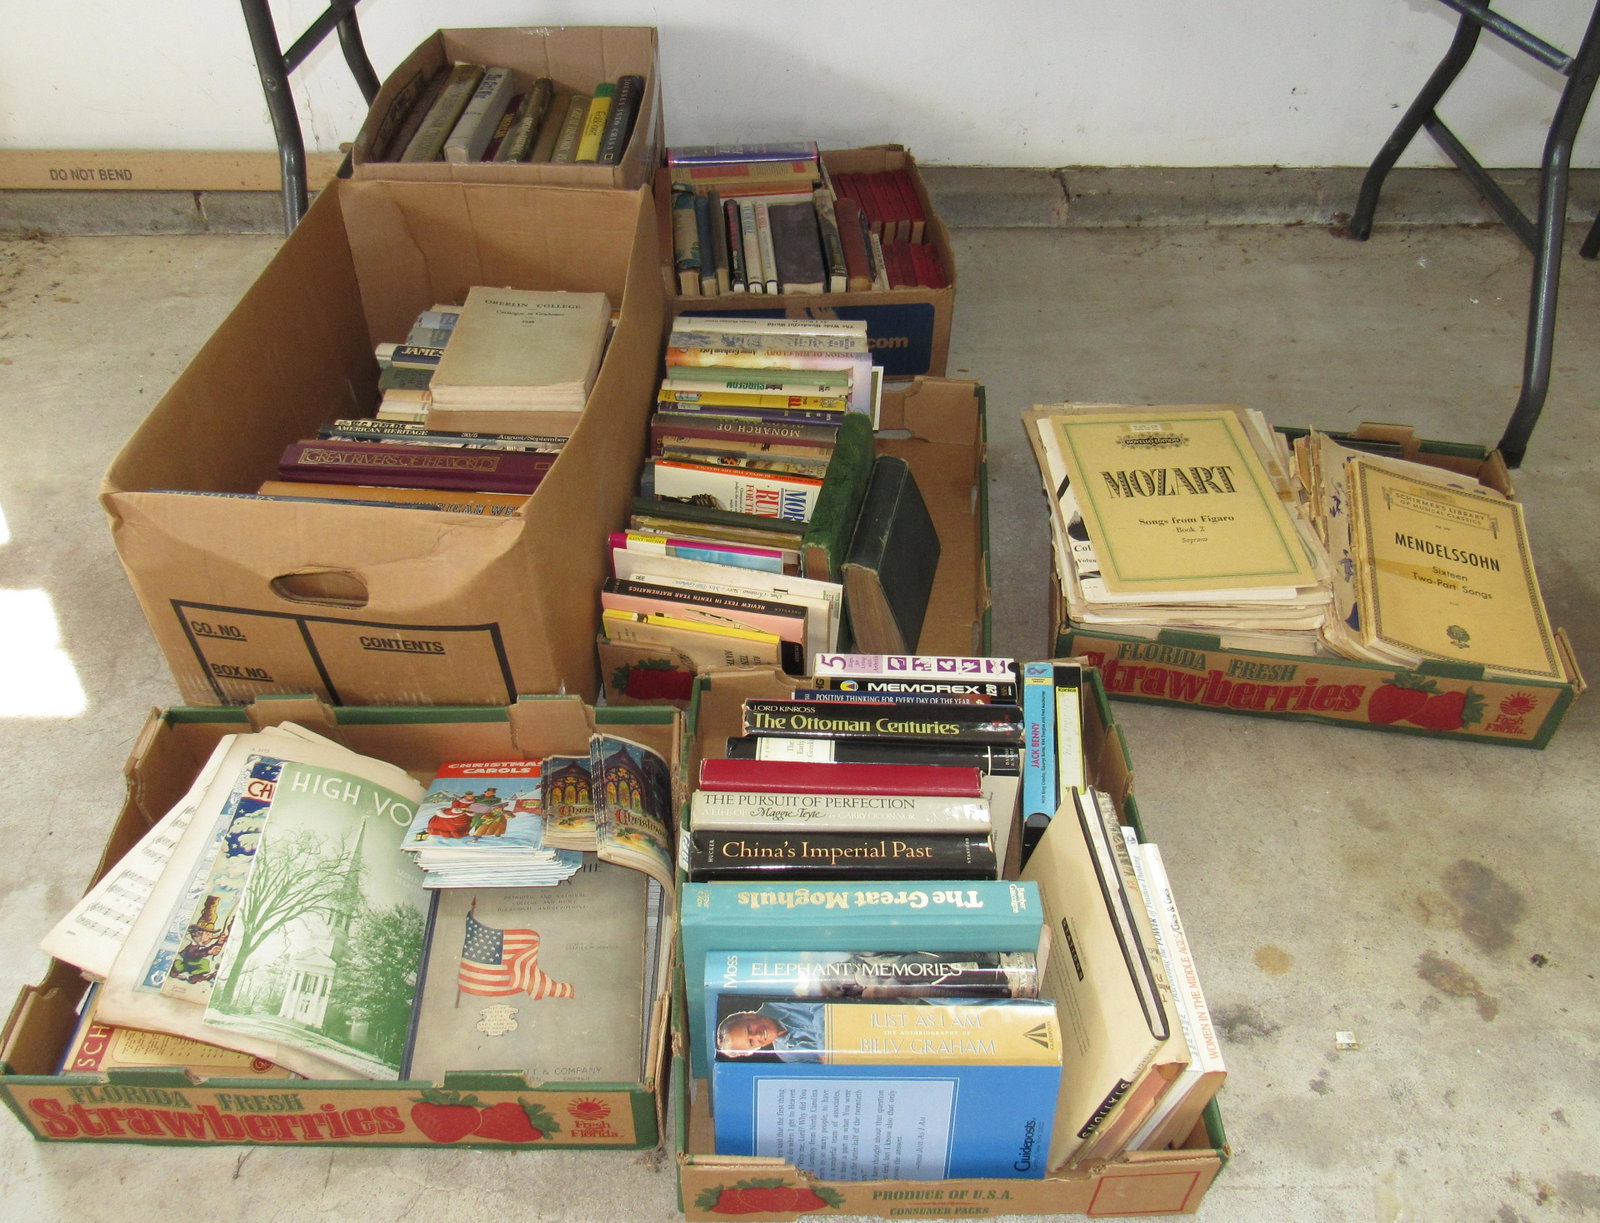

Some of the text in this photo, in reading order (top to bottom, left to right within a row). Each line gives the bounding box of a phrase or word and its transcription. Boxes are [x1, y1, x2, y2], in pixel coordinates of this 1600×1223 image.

[49, 169, 133, 181] DO NOT BEND
[485, 300, 528, 308] OBERLIN
[401, 347, 443, 357] JAMES
[383, 427, 428, 436] HERITAGE
[716, 423, 731, 431] OF
[737, 425, 800, 438] MONARCH
[306, 451, 350, 464] GREAT
[350, 453, 398, 465] RIVERS
[1099, 466, 1238, 499] MOZART
[1139, 514, 1235, 527] Songs from Figaro
[1413, 503, 1444, 516] MUSICAL
[1446, 513, 1483, 526] CLASSICS
[1449, 506, 1485, 520] LIBRARY
[1394, 531, 1501, 573] MENDELSSOHN
[1432, 565, 1468, 582] Sixteen
[628, 586, 674, 598] MATHEMATICS
[1411, 571, 1493, 600] Two-Part Songs
[723, 599, 740, 607] TEXT
[741, 602, 766, 610] REVIEW
[191, 621, 246, 638] CO. NO.
[359, 636, 445, 653] CONTENTS
[821, 655, 847, 670] 5
[1117, 643, 1298, 681] FLORIDA FRESH
[211, 663, 273, 680] BOX NO.
[867, 683, 980, 694] MEMOREX
[985, 684, 997, 697] 120
[816, 694, 844, 702] POSITIVE
[845, 695, 880, 703] THINKING
[753, 705, 816, 713] LORD KINROSS
[753, 713, 960, 735] The Ottoman Centuries
[1030, 722, 1041, 769] JACK BENNY
[291, 772, 361, 806] HIGH
[703, 794, 915, 809] THE PURSUIT OF PERFECTION
[750, 806, 826, 821] Maggie Teyte
[722, 840, 933, 865] China's Imperial Past
[737, 888, 984, 909] The Great Moghuls
[1016, 887, 1027, 910] Bamber
[1149, 917, 1163, 947] POWER
[751, 962, 963, 978] ELEPHANT MEMORIES
[1183, 956, 1199, 990] MIDDLE
[1194, 989, 1203, 1009] THE
[871, 1013, 983, 1028] JUST AS I AM
[1199, 1009, 1207, 1023] IN
[860, 1039, 996, 1055] BILLY GRAHAM
[1203, 1023, 1219, 1059] WOMEN
[554, 1067, 602, 1075] COMPANY
[66, 1086, 305, 1113] FLORIDA FRESH
[1081, 1082, 1131, 1139] STATIONS
[29, 1098, 405, 1141] Strawberries
[575, 1120, 611, 1128] Fresh
[872, 1189, 1014, 1201] PRODUCE OF U.S.A.
[889, 1207, 990, 1217] CONSUMER PACKS
